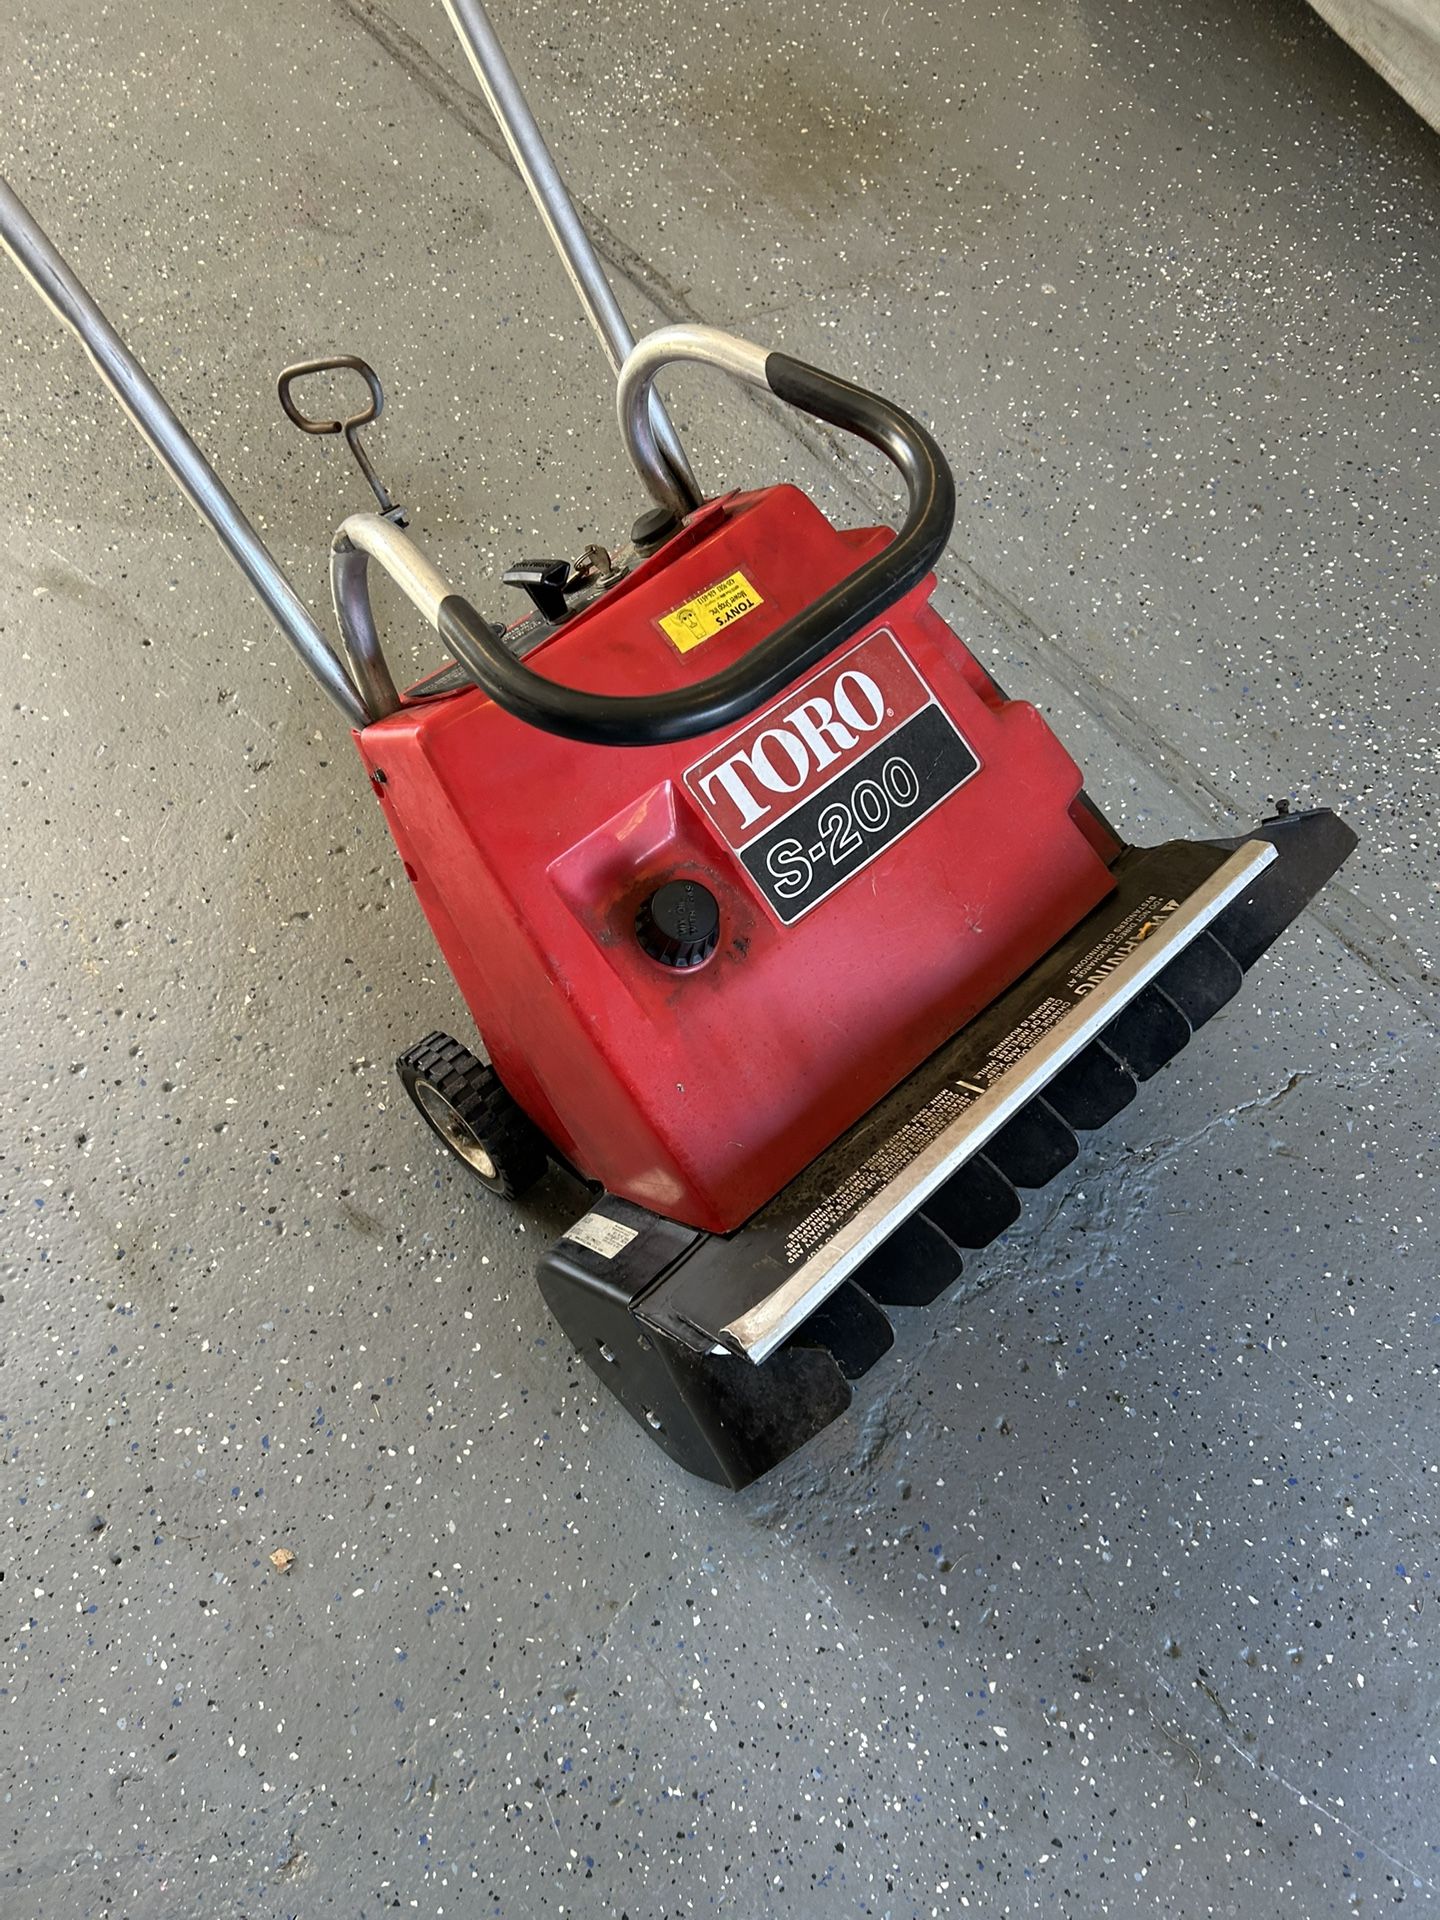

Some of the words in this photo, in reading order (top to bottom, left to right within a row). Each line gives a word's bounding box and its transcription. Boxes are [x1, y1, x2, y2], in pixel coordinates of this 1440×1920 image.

[717, 599, 731, 610] Shop
[730, 590, 747, 603] Mower
[716, 598, 754, 626] TONY'S
[698, 671, 884, 829] TORO
[766, 756, 919, 898] S-200
[1112, 895, 1156, 932] BYSTANDERS
[1134, 909, 1151, 922] NOT
[1147, 900, 1161, 909] DO
[1101, 932, 1116, 943] OR
[1111, 922, 1138, 943] DIRECT
[1066, 943, 1105, 976] WINDOWS.
[1074, 943, 1115, 978] DISCHARGE
[1064, 978, 1078, 987] AT
[1026, 996, 1056, 1020] ENGINE
[1037, 998, 1064, 1019] CLEAR
[1039, 1000, 1072, 1027] CHARGE
[1019, 1019, 1030, 1027] IS
[1028, 1018, 1042, 1028] OF
[985, 1027, 1023, 1058] RUNNING.
[994, 1028, 1032, 1059] IMPELLER
[1018, 1026, 1044, 1047] GUIDE
[1001, 1047, 1021, 1062] AND
[972, 1058, 998, 1080] WHILE
[983, 1062, 1005, 1078] KEEP
[877, 1148, 910, 1176] MANUAL
[828, 1189, 867, 1223] COMPLETE
[782, 1204, 835, 1250] MINNEAPOLIS,
[784, 1206, 823, 1240] NUMBERS.
[800, 1210, 837, 1242] MANUALS
[802, 1223, 832, 1248] SAFETY
[784, 1242, 802, 1257] ARE
[785, 1247, 806, 1264] AND
